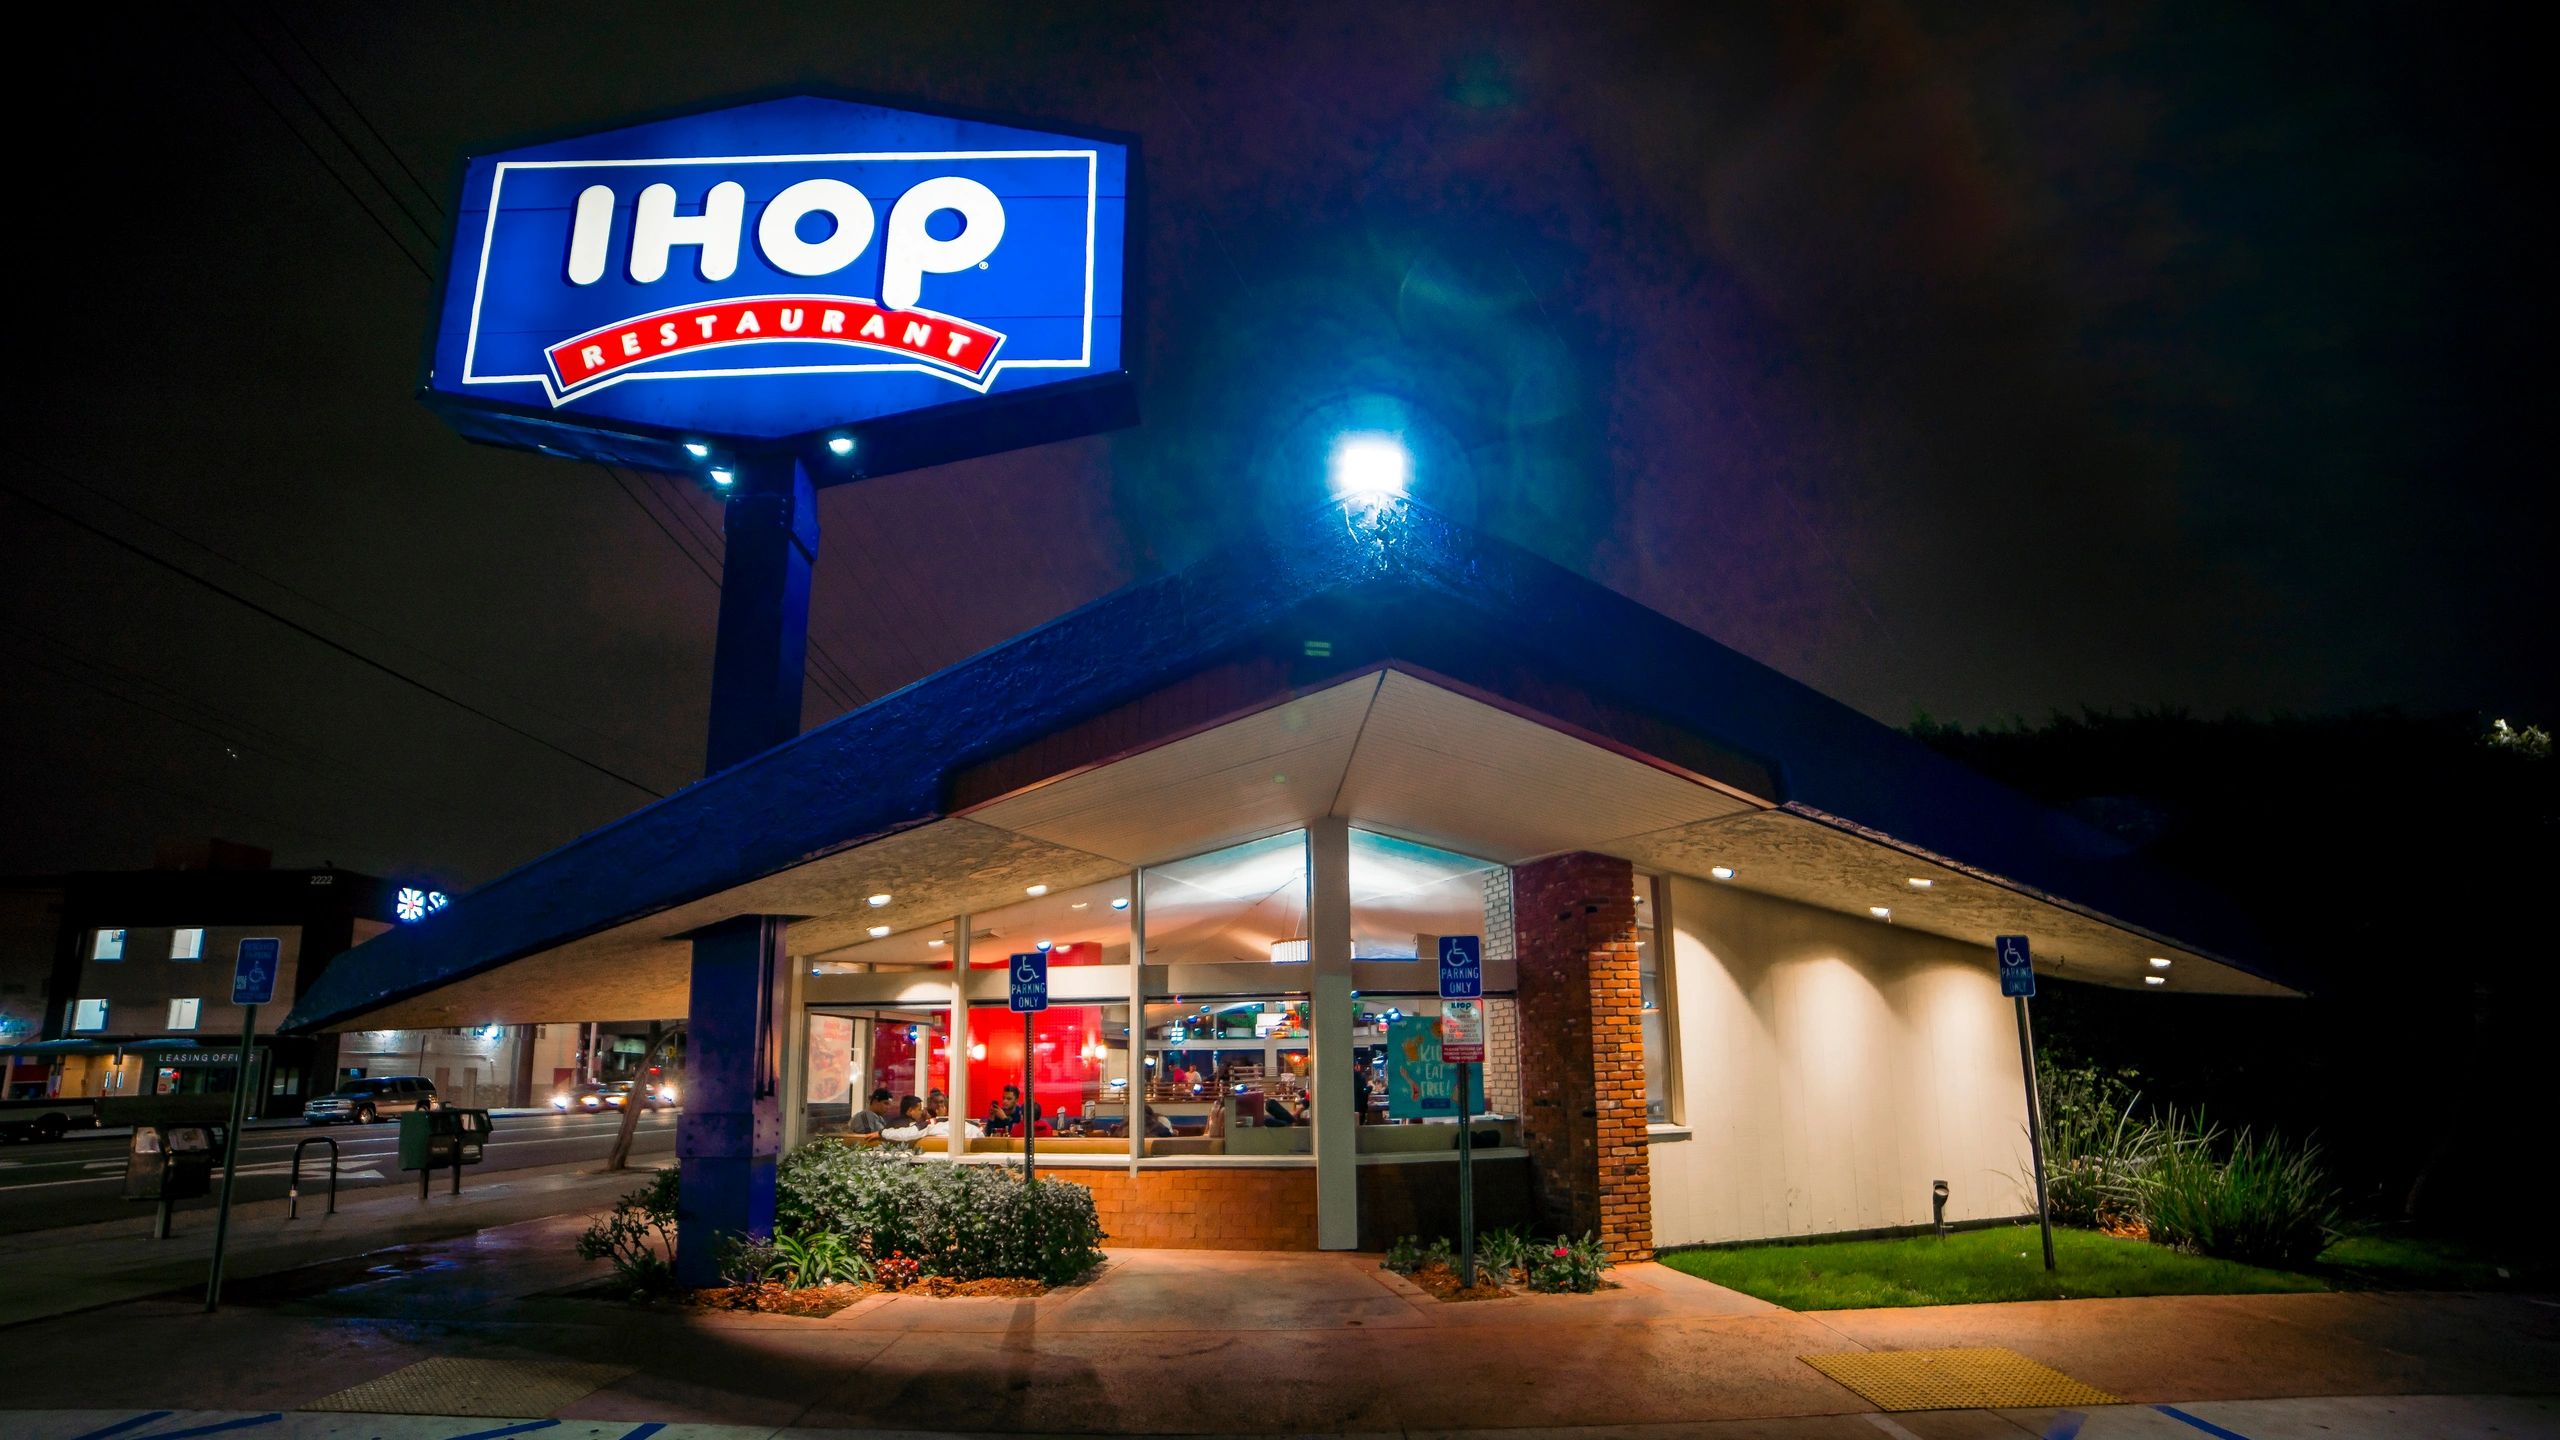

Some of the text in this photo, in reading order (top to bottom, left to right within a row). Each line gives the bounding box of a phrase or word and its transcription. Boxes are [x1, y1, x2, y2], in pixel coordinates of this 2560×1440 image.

[568, 176, 1006, 310] IHOP
[580, 307, 972, 371] RESTAURANT
[310, 875, 333, 885] 2222
[1441, 967, 1479, 979] PARKING
[1011, 982, 1046, 995] PARKING
[1449, 981, 1472, 994] ONLY
[1018, 996, 1039, 1008] ONLY
[159, 1053, 256, 1062] LEASING OFFIE
[1425, 1063, 1444, 1079] EAT
[1420, 1080, 1450, 1097] FREE!
